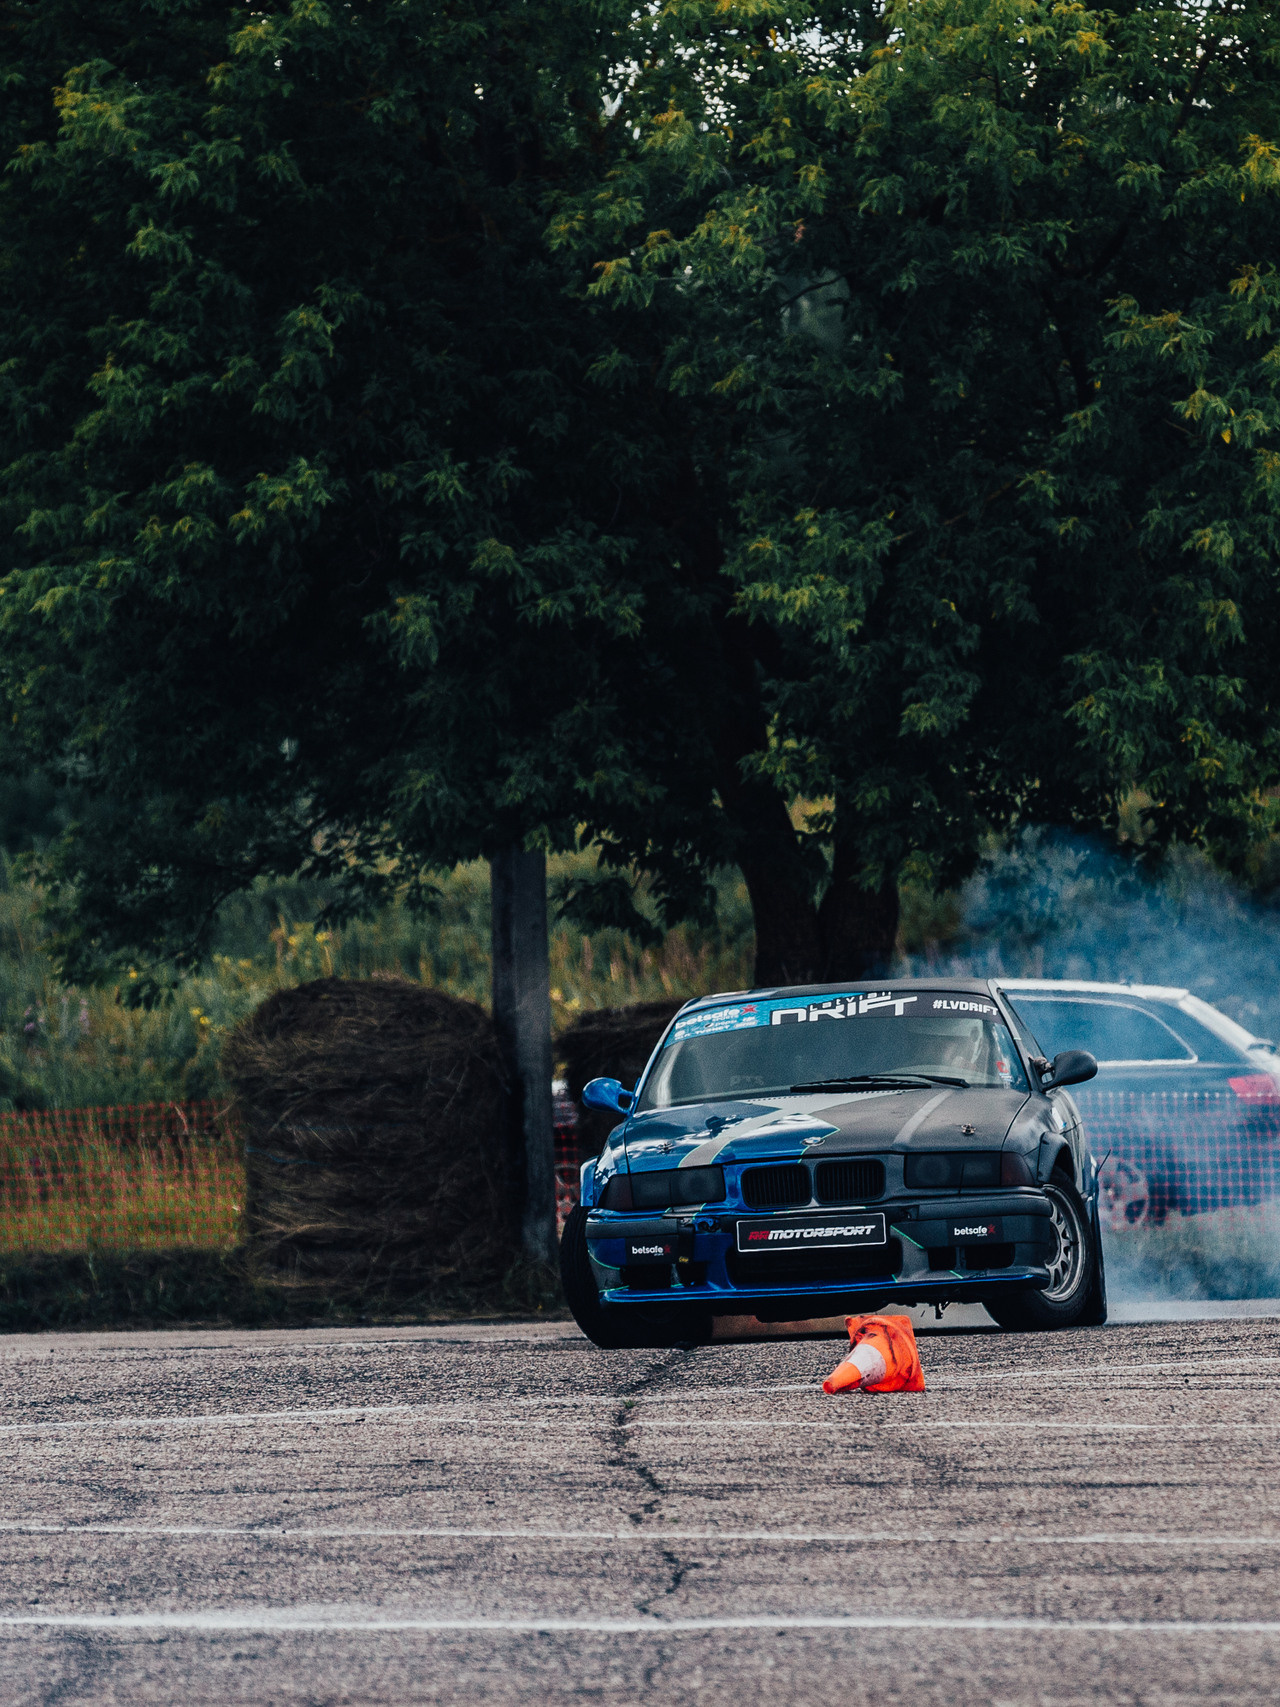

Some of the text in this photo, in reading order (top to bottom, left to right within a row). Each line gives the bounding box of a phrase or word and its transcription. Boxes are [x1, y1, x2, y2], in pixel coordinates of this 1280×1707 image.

[932, 999, 999, 1016] #LVDRIFT
[675, 1008, 740, 1030] betsafe
[953, 1225, 988, 1236] betsafe
[631, 1245, 664, 1255] betsafe
